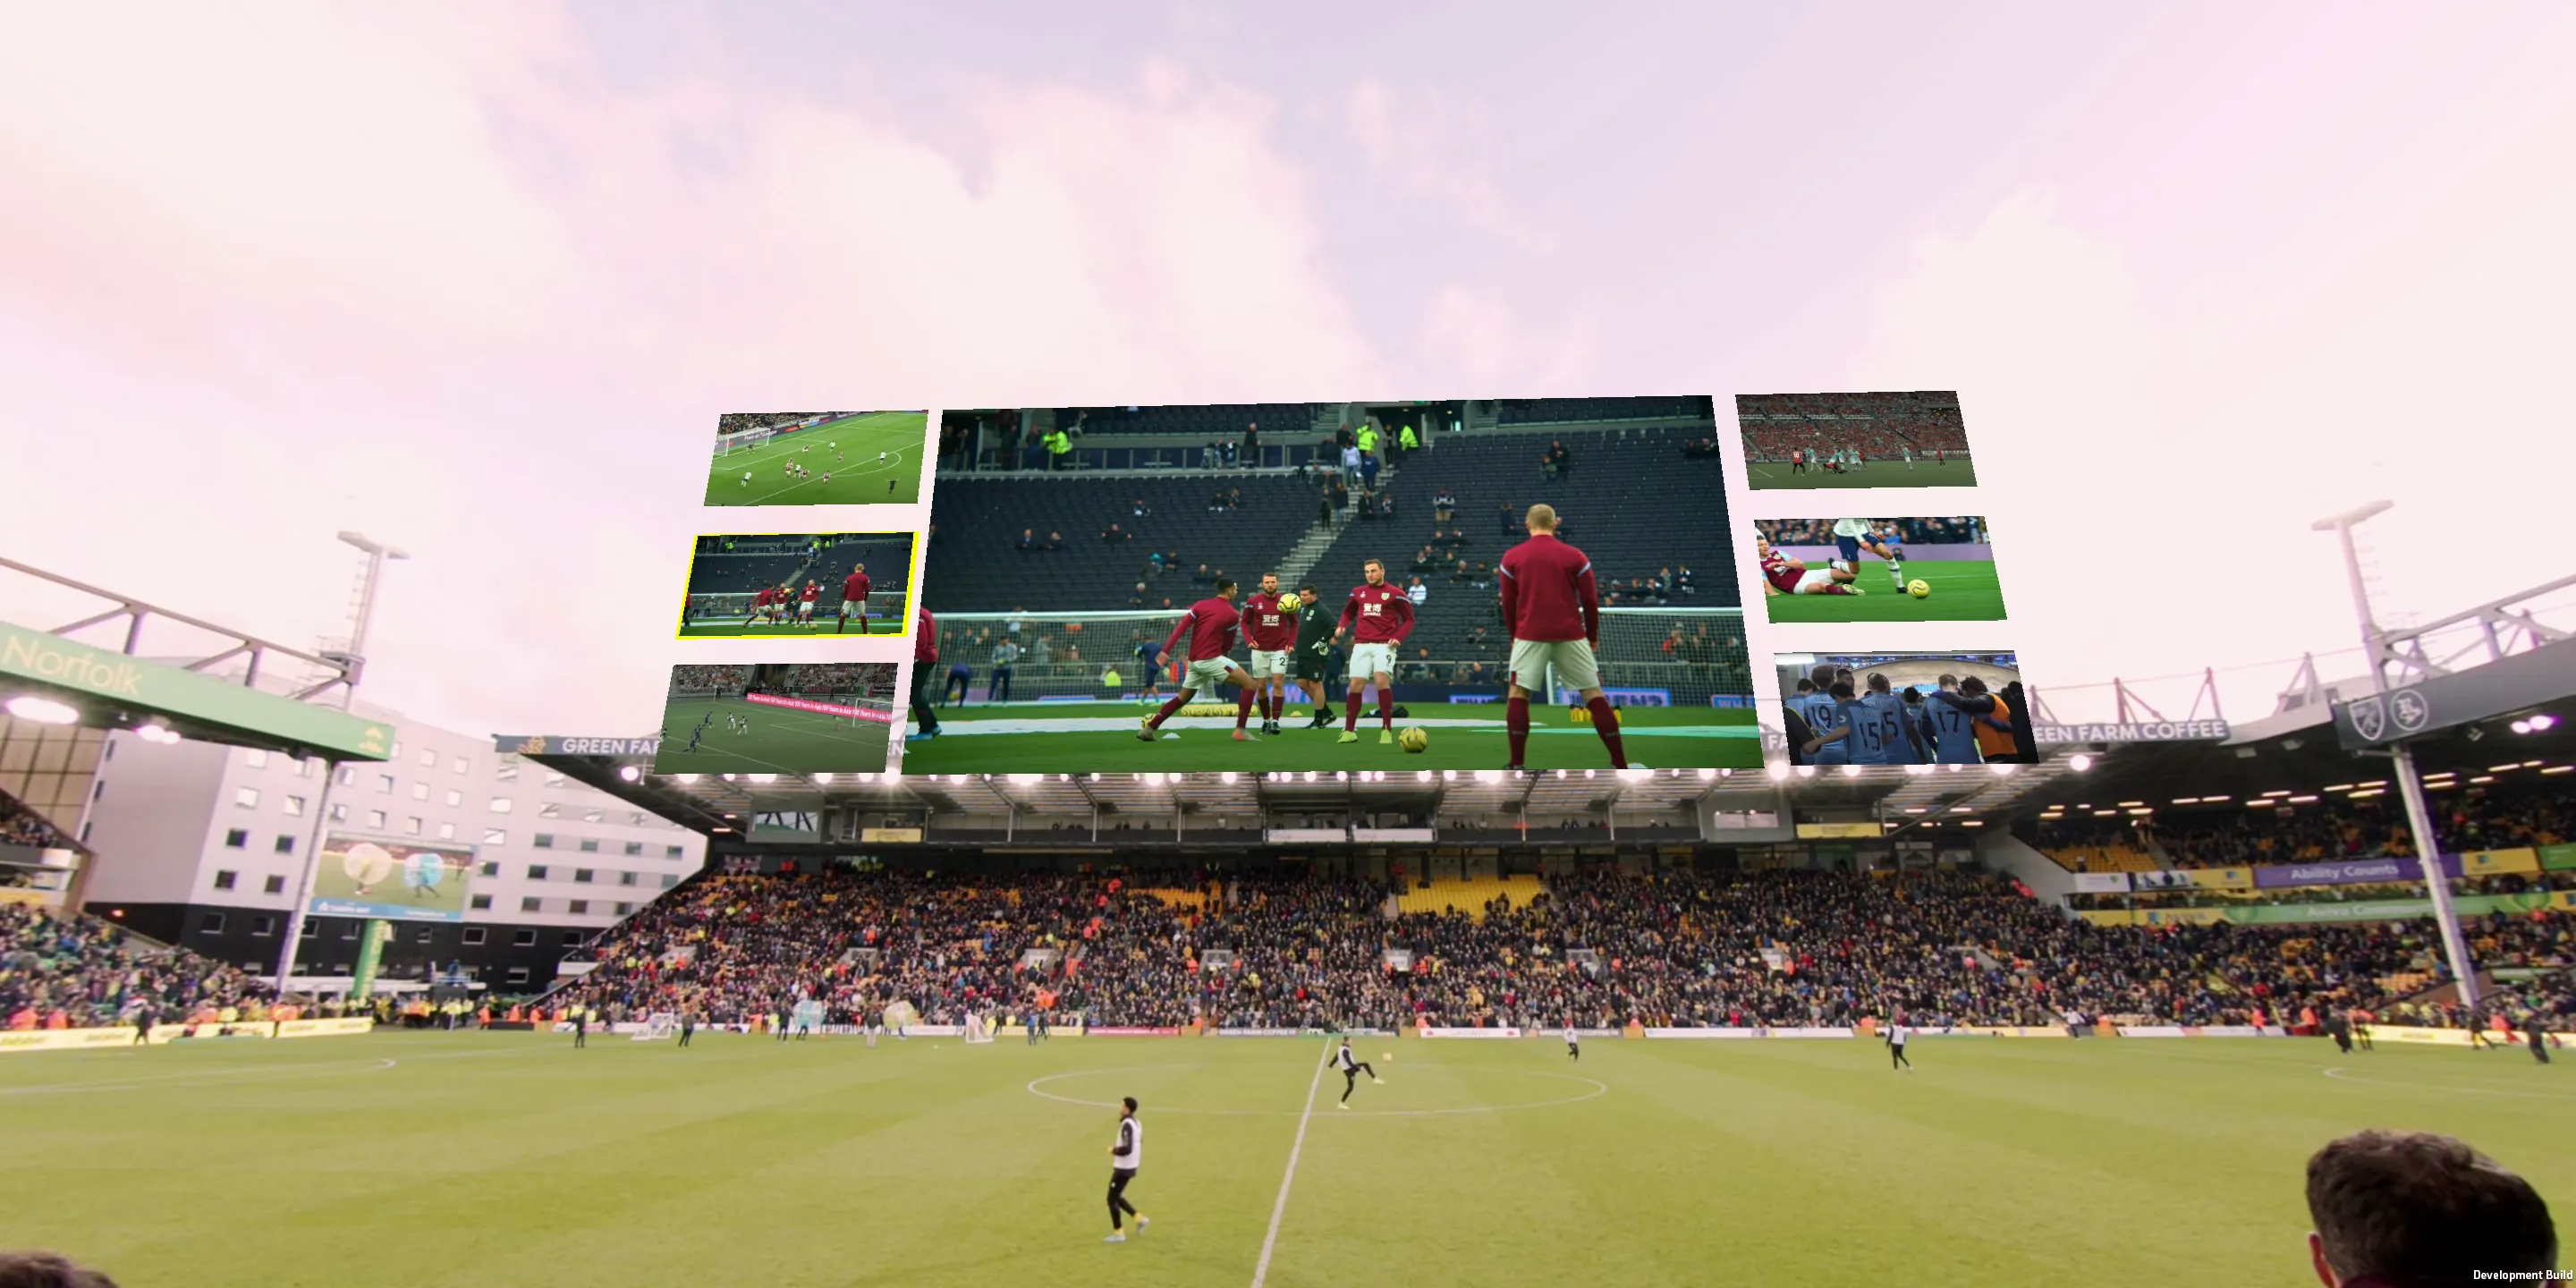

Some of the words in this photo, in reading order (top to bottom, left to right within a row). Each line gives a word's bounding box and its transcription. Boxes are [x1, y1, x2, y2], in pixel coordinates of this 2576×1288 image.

[2, 635, 142, 696] Norfolk
[1279, 657, 1286, 666] 2
[1385, 655, 1392, 664] 9
[1810, 705, 1833, 730] 19
[1936, 710, 1961, 734] 17
[1859, 722, 1880, 752] 15
[2078, 724, 2139, 741] FARM
[2142, 721, 2226, 740] COFFEE
[562, 738, 625, 755] GREEN
[2291, 866, 2340, 880] Ability
[2343, 864, 2400, 877] Counts
